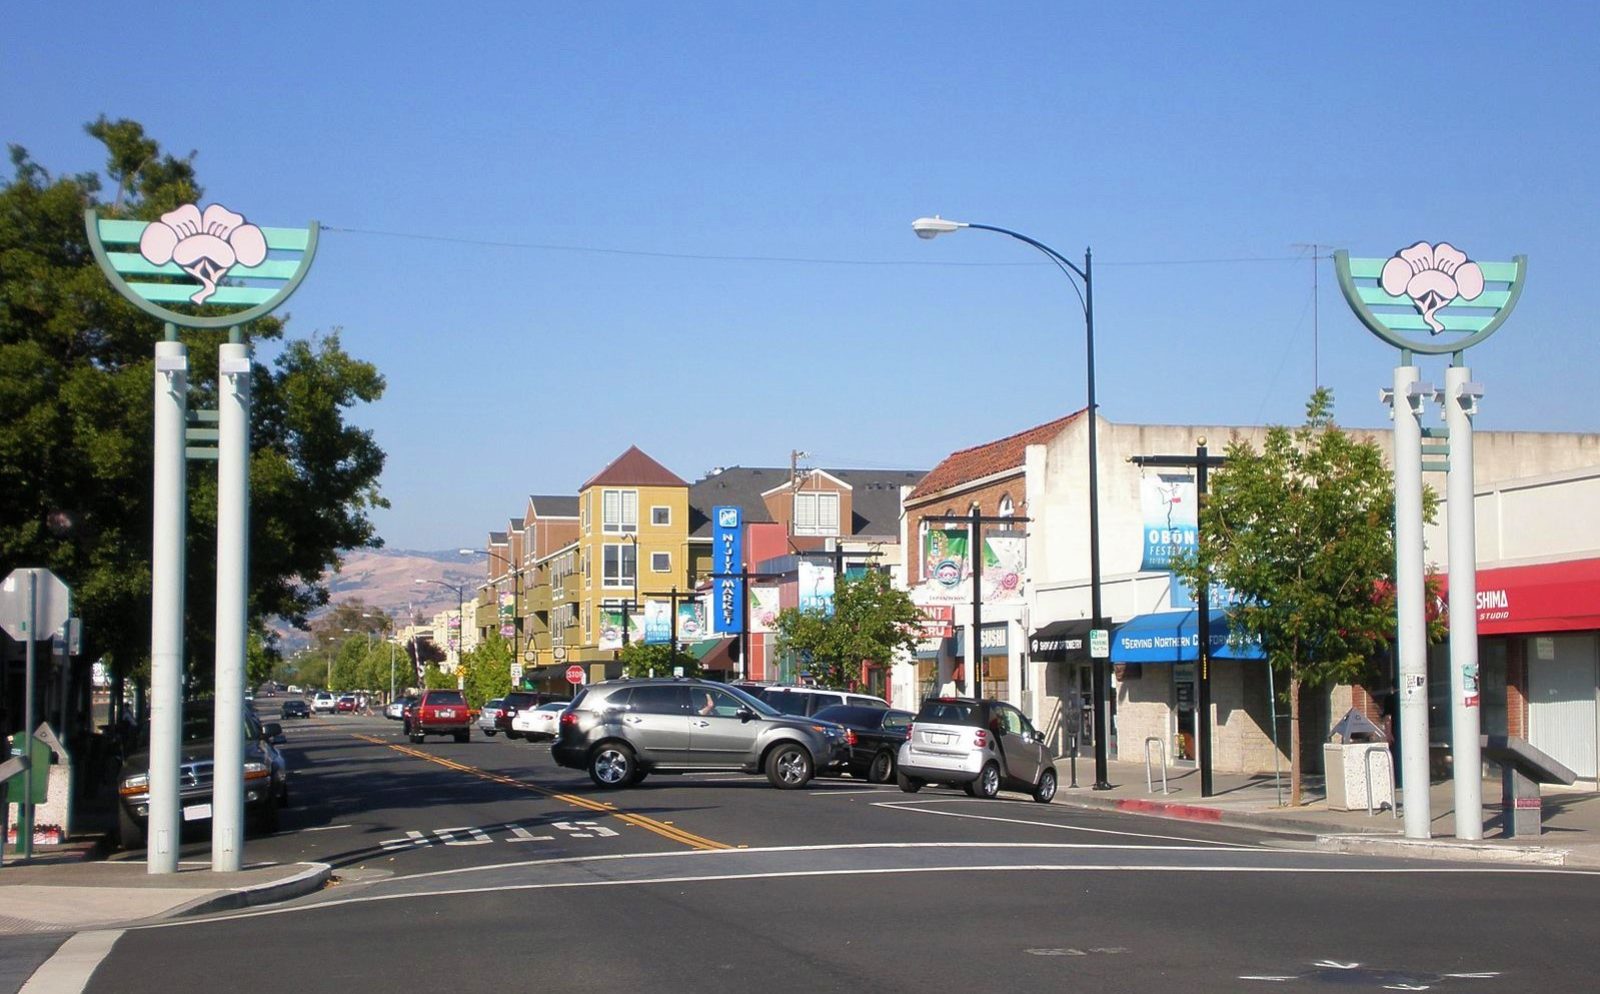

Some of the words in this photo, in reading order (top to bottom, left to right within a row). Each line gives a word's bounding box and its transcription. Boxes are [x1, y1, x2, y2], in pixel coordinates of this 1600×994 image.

[721, 533, 735, 575] NIJIYA
[721, 579, 735, 624] MARKET
[1476, 589, 1509, 610] SHIMA
[1479, 611, 1510, 620] STUDIO
[1154, 636, 1190, 648] NORTHERN
[567, 670, 583, 678] STOP
